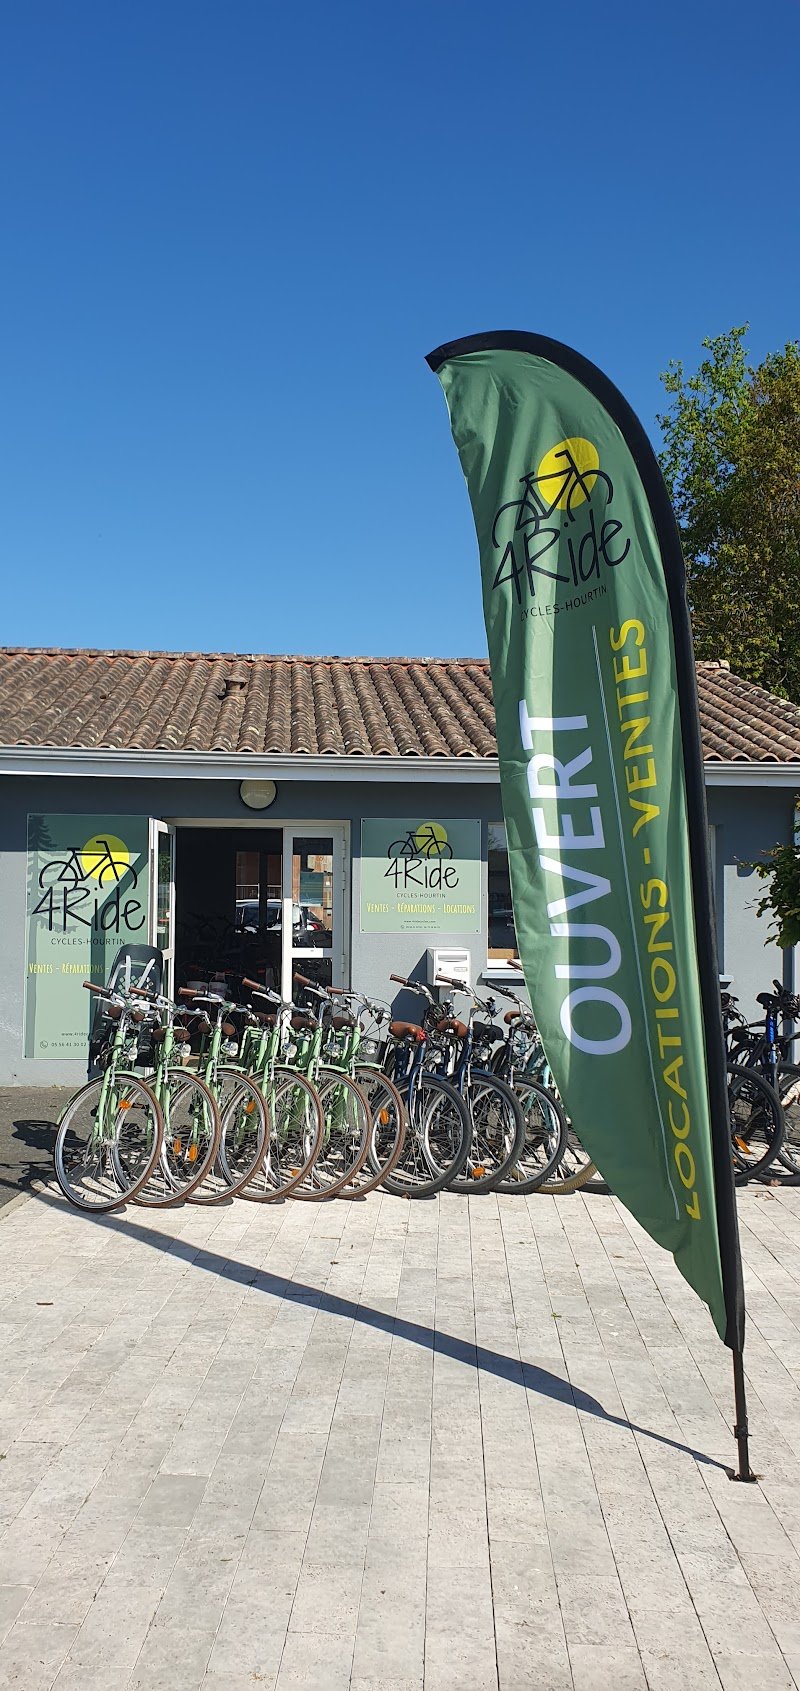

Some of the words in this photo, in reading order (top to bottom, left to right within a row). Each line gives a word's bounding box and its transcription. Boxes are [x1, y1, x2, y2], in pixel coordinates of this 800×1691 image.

[492, 509, 631, 605] 4Ride
[520, 584, 607, 622] CYCLES-HOURTIN
[609, 618, 661, 838] VENTES
[384, 857, 459, 890] 4Ride
[518, 699, 633, 1056] OUVERT
[31, 886, 146, 933] 4Ride
[443, 904, 476, 914] LOCATIONS
[50, 937, 126, 946] CYCLES-HOURTIN
[638, 877, 701, 1220] LOCATIONS
